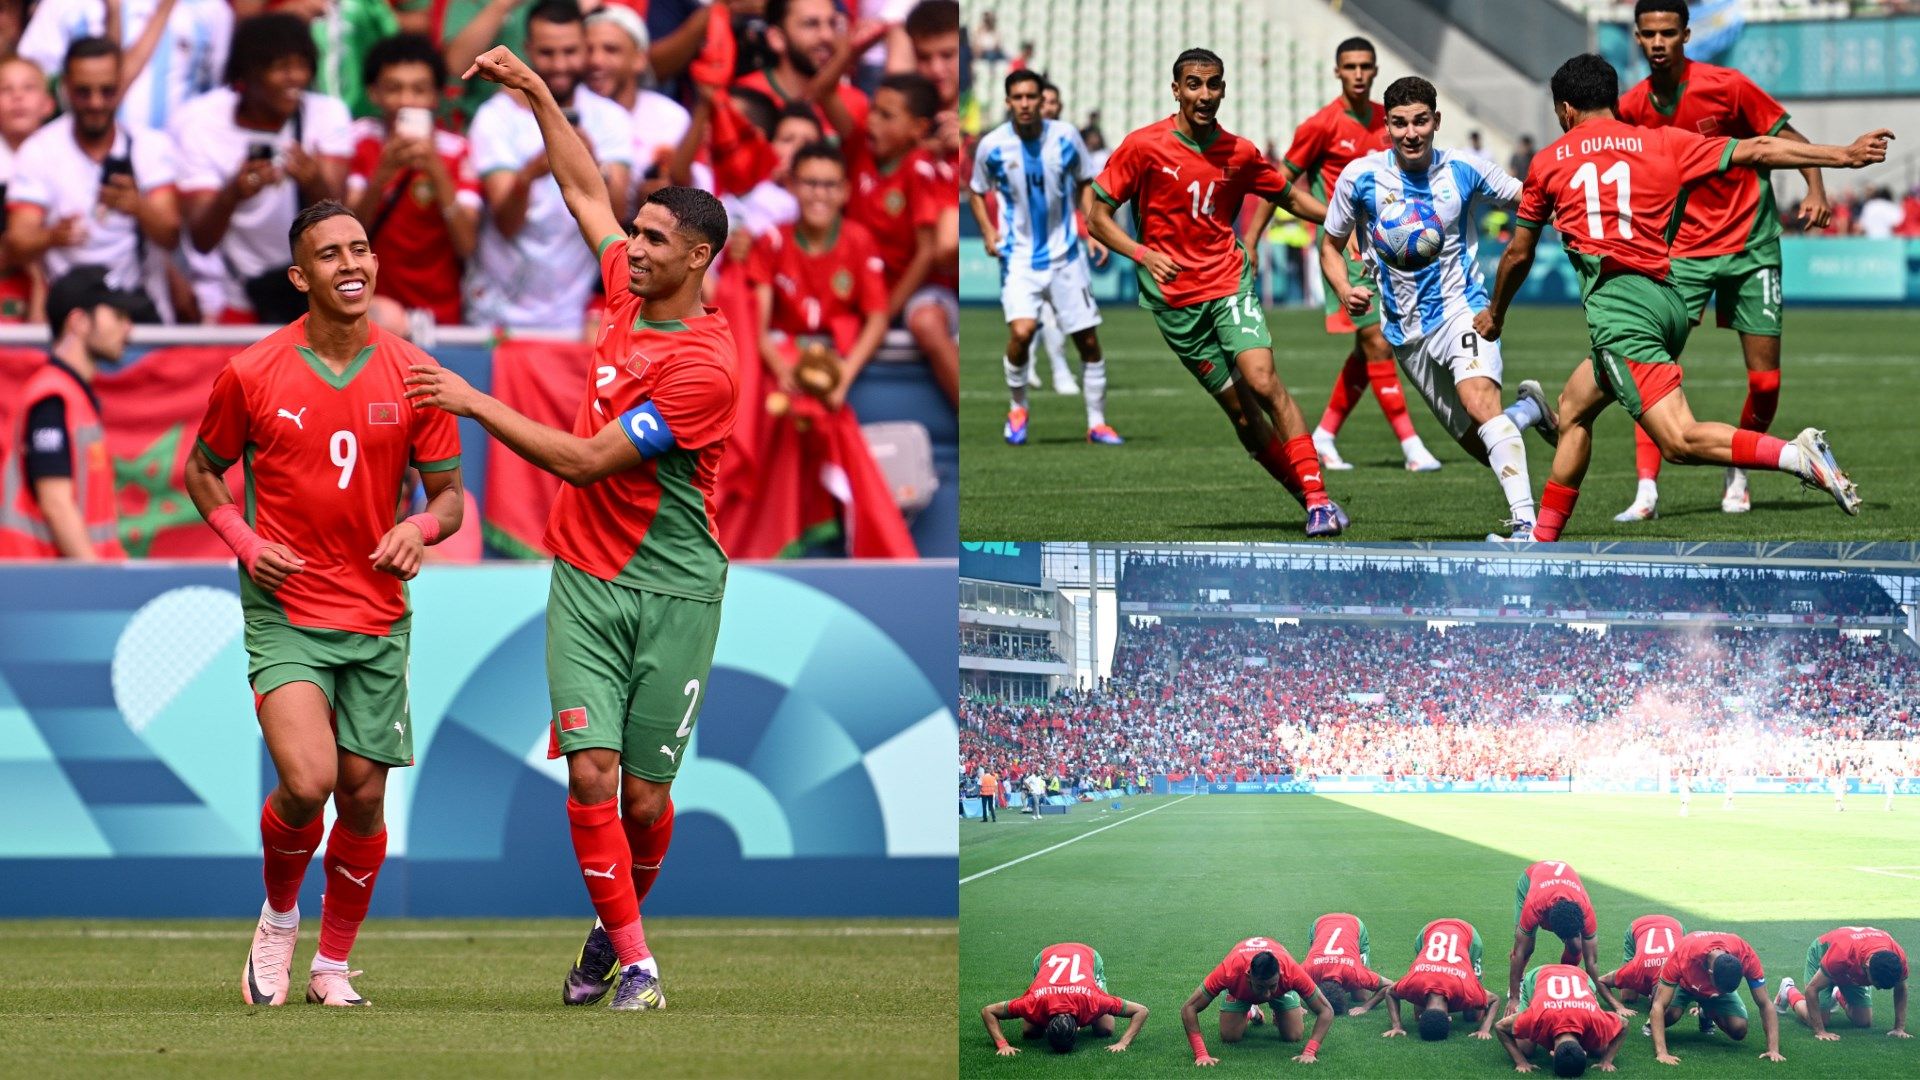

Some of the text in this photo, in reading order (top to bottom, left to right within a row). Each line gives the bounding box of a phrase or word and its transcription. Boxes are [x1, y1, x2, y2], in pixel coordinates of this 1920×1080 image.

[1819, 36, 1918, 78] PARS
[1556, 136, 1643, 161] EL OUAHDI
[1025, 171, 1045, 196] 14
[1187, 180, 1216, 220] 14
[1570, 160, 1634, 240] 11
[1227, 290, 1263, 325] 14
[1461, 331, 1479, 357] 9
[630, 411, 659, 440] C
[329, 430, 358, 490] 9
[675, 678, 700, 738] 2
[1323, 927, 1345, 956] 7
[1425, 931, 1463, 964] 18
[1644, 927, 1675, 955] 17
[1047, 953, 1086, 984] 14
[1340, 957, 1355, 967] BEN
[1414, 963, 1467, 979] RICHARDSON
[1033, 985, 1092, 999] TARGHALLINE
[1546, 974, 1590, 1000] 10
[1543, 1000, 1597, 1012] AKHOMACH
